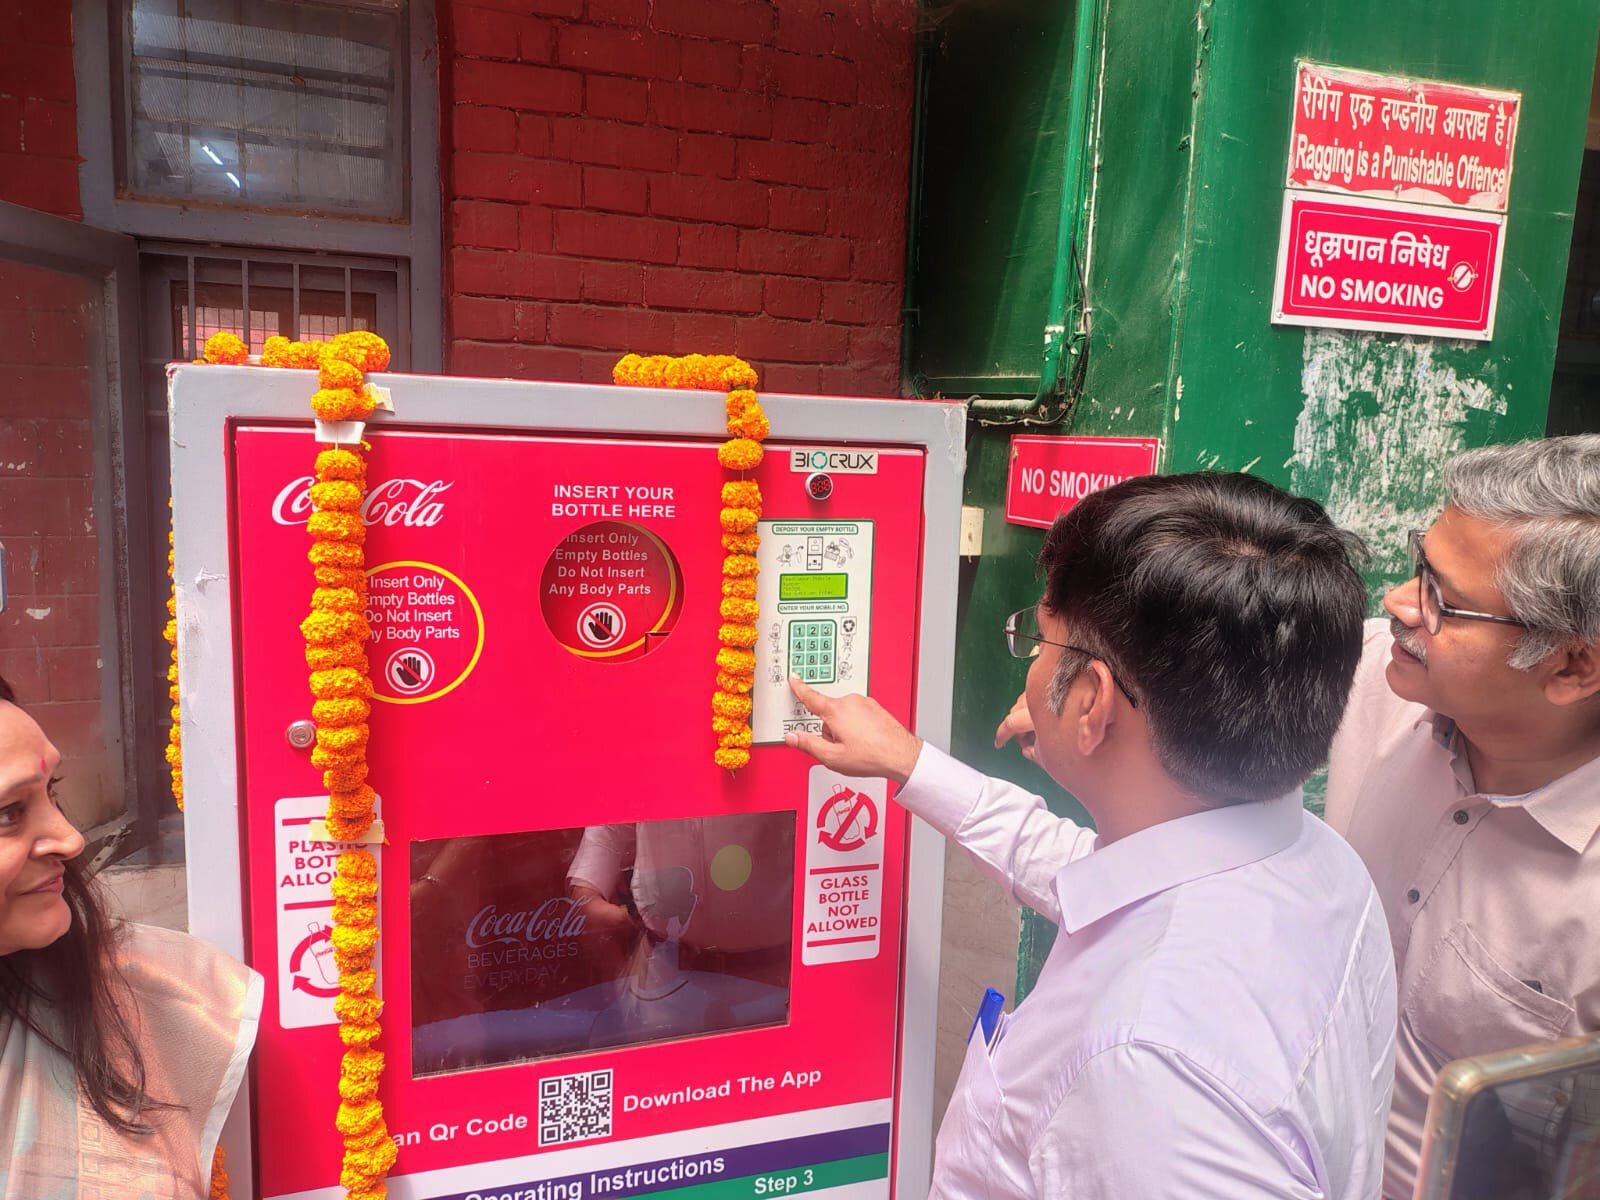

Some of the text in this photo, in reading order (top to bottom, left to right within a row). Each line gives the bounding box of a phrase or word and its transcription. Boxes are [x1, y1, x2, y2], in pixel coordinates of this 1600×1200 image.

[1349, 93, 1375, 130] एक
[1381, 91, 1438, 135] दण्डनीय
[1443, 106, 1491, 142] अपराध
[1296, 133, 1505, 193] Ragging is a Punishable Offence
[1304, 230, 1450, 270] धूम्रपान निषेध
[1301, 274, 1445, 310] NO SMOKING
[795, 451, 873, 469] BIOCRUX
[1021, 467, 1134, 498] NO SMOKI
[554, 485, 674, 500] INSERT YOUR
[552, 503, 676, 518] BOTTLE HERE
[608, 532, 639, 546] Only
[555, 548, 648, 563] Empty Bottles
[558, 566, 645, 578] Do Not Insert
[370, 575, 445, 591] Insert Only
[549, 583, 651, 597] Any Body Parts
[407, 591, 455, 606] Bottles
[386, 609, 410, 622] Not
[414, 609, 452, 622] Insert
[386, 625, 422, 642] Body
[425, 625, 460, 639] Parts
[810, 627, 816, 635] 2
[824, 626, 830, 635] 3
[796, 640, 829, 649] 4 5 6
[795, 655, 828, 664] 7 8 9
[809, 669, 814, 677] 0
[280, 871, 338, 887] ALLO
[820, 875, 868, 889] GLASS
[819, 889, 869, 904] BOTTLE
[828, 904, 859, 917] NOT
[465, 895, 592, 948] Coca-Cola
[807, 916, 878, 933] ALLOWED
[468, 942, 577, 969] BEVERAGES
[464, 965, 560, 989] EVERYDAY
[623, 1069, 822, 1112] Download The App
[429, 1123, 459, 1141] Qr
[466, 1113, 528, 1136] Code
[591, 1156, 725, 1194] Instructions
[754, 1168, 813, 1195] Step 3
